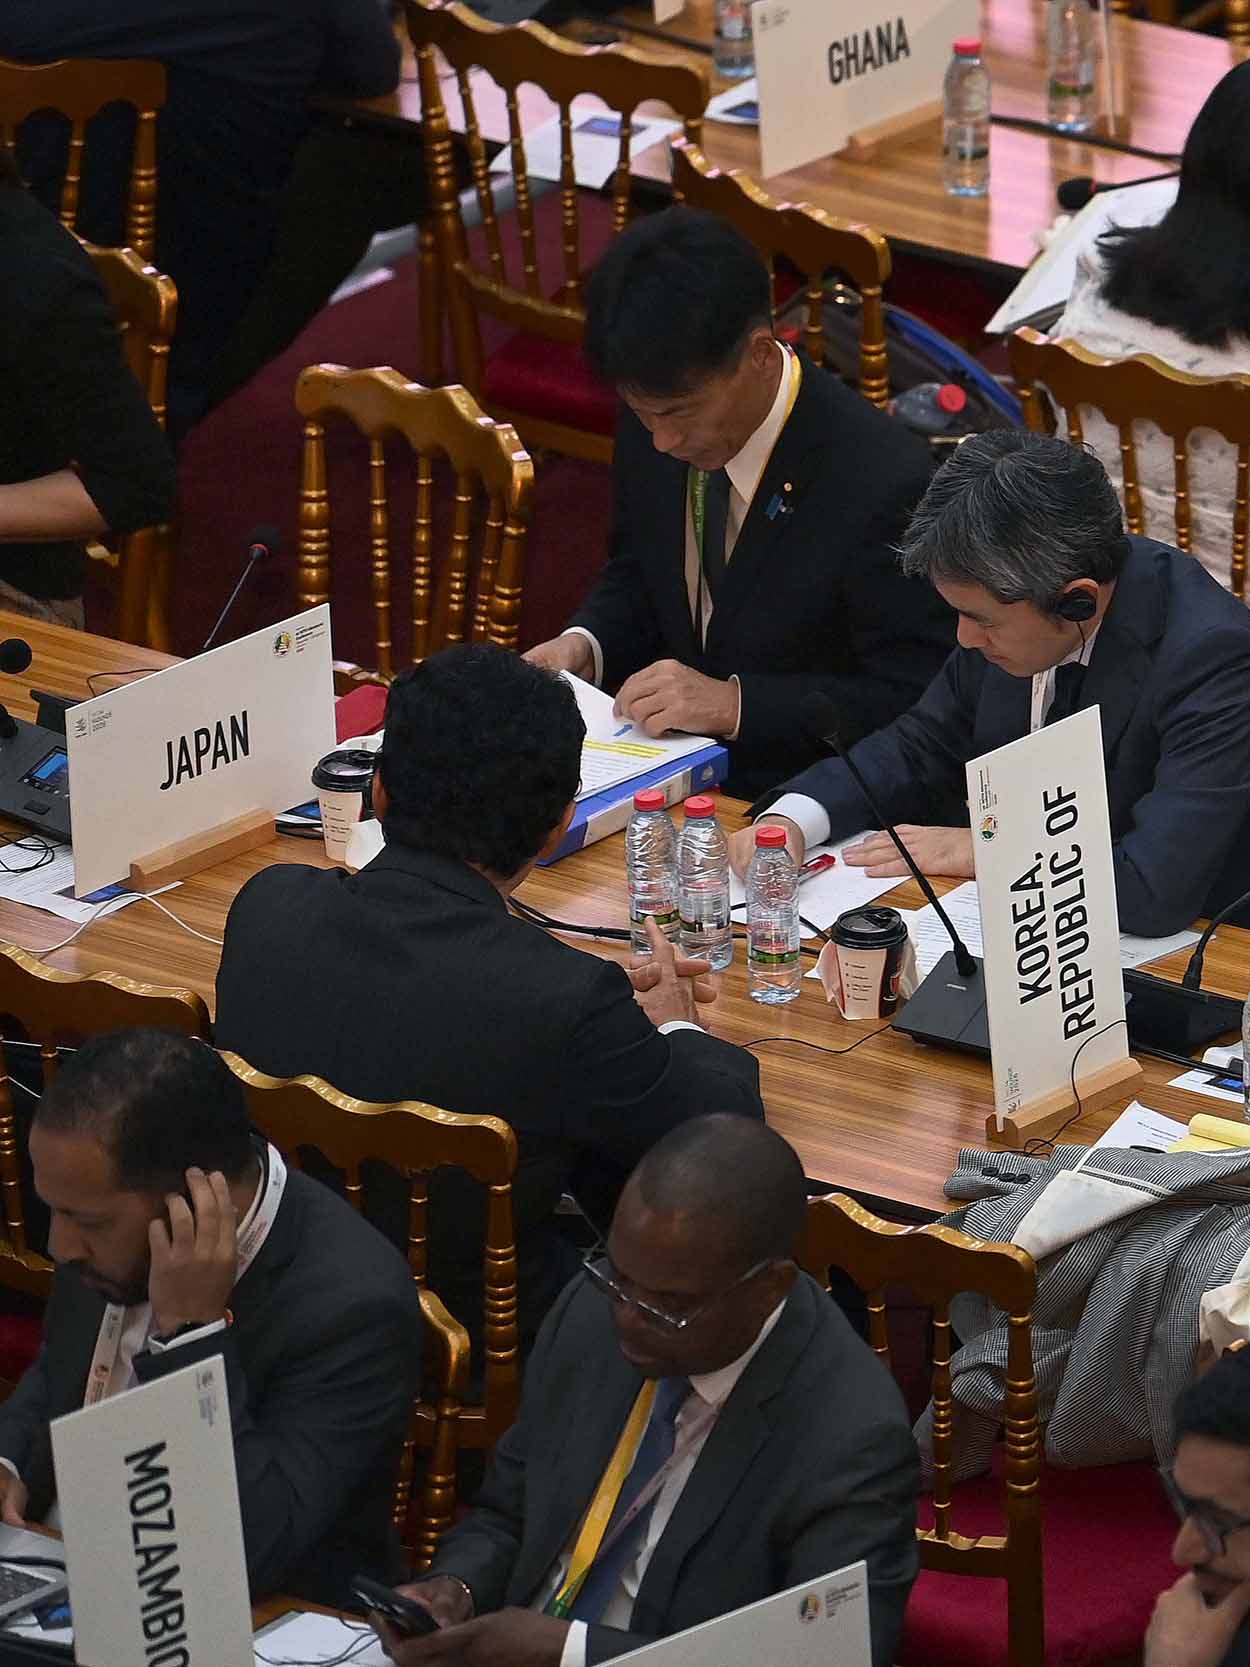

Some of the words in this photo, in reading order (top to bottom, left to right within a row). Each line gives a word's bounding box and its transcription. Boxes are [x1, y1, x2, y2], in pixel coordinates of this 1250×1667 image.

[828, 16, 911, 85] GHANA
[159, 710, 250, 790] JAPAN
[1042, 785, 1079, 838] OF
[1010, 852, 1053, 1005] KOREA,
[1049, 843, 1096, 1041] REPUBLIC
